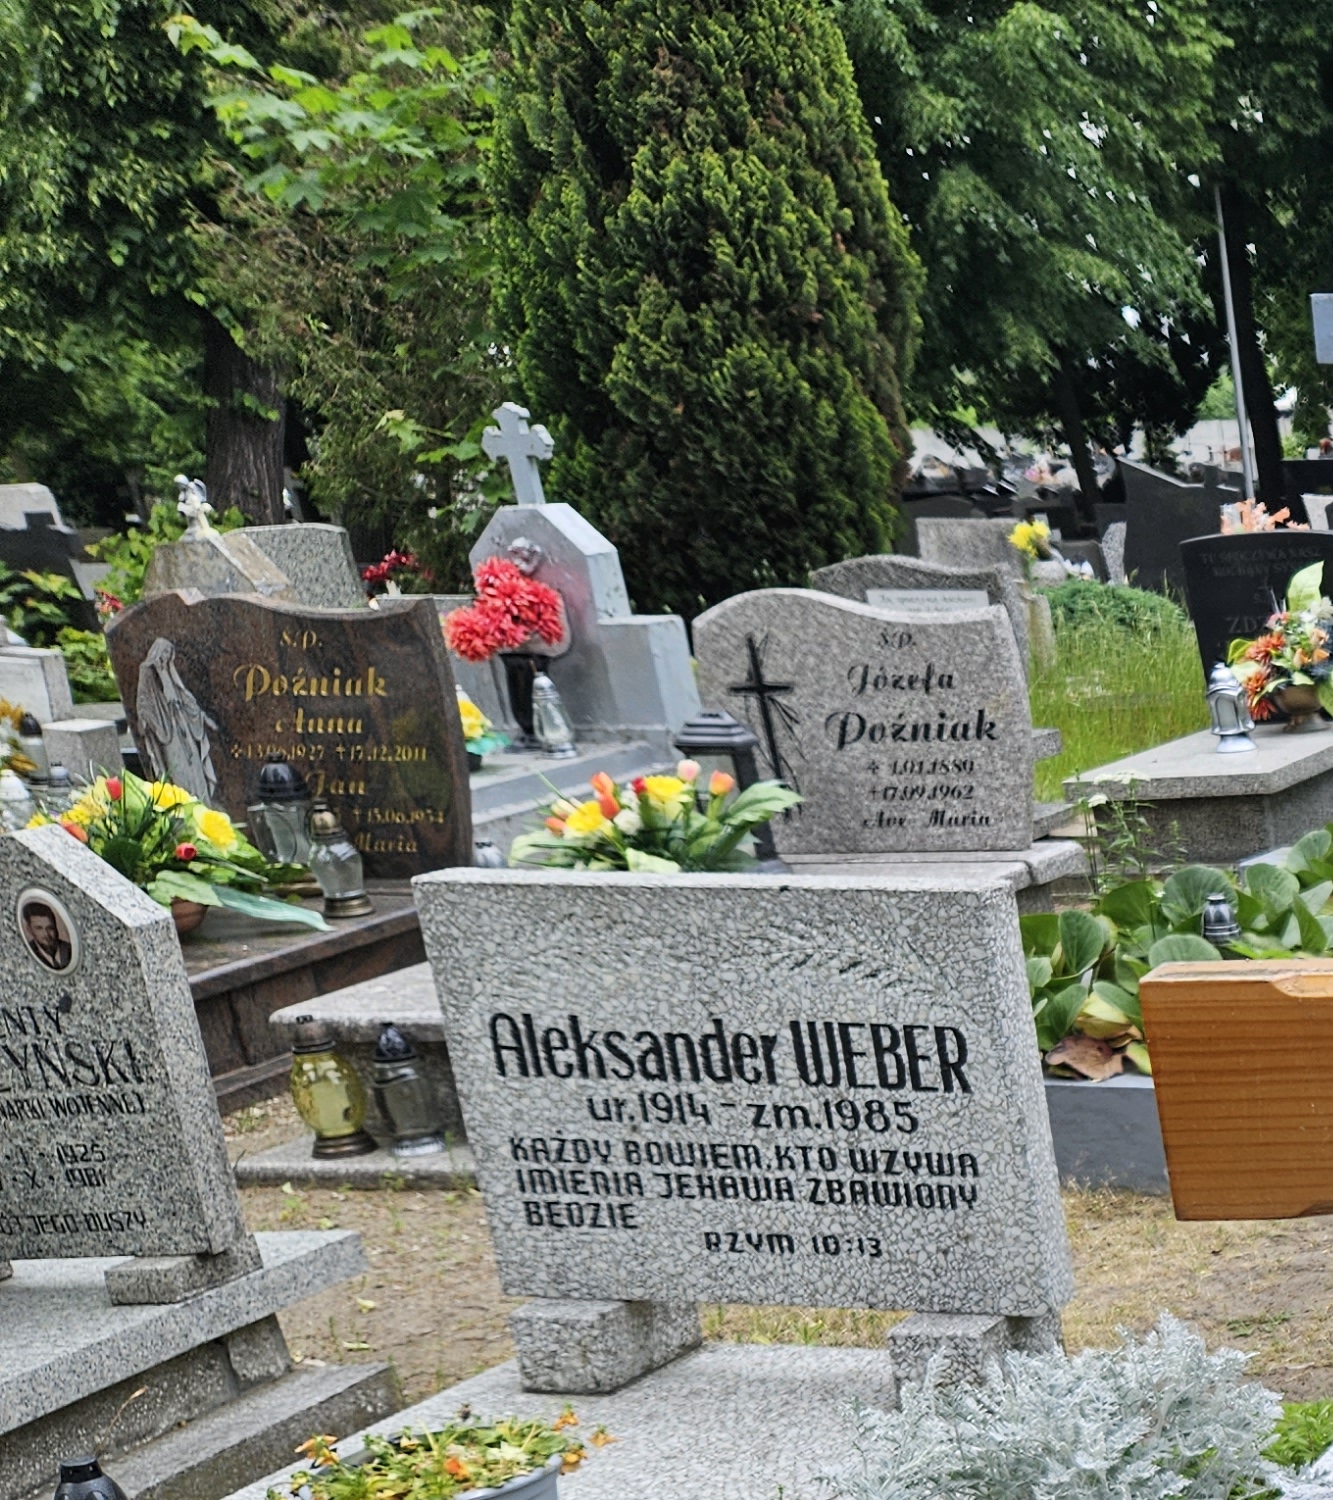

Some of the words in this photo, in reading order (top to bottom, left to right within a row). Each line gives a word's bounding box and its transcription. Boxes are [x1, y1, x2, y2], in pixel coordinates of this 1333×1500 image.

[232, 662, 389, 702] Poźniak
[846, 662, 956, 698] Józefa
[824, 708, 999, 750] Poźniak
[0, 1037, 147, 1091] YŃSKI
[488, 1012, 778, 1086] Aleksander
[788, 1020, 974, 1094] WEBER
[509, 1129, 612, 1164] KAŻDY
[849, 1149, 980, 1178] WZYWA
[515, 1168, 645, 1197] IMIENIA
[806, 1177, 979, 1210] ZBAWIONY
[703, 1231, 795, 1255] RZYM
